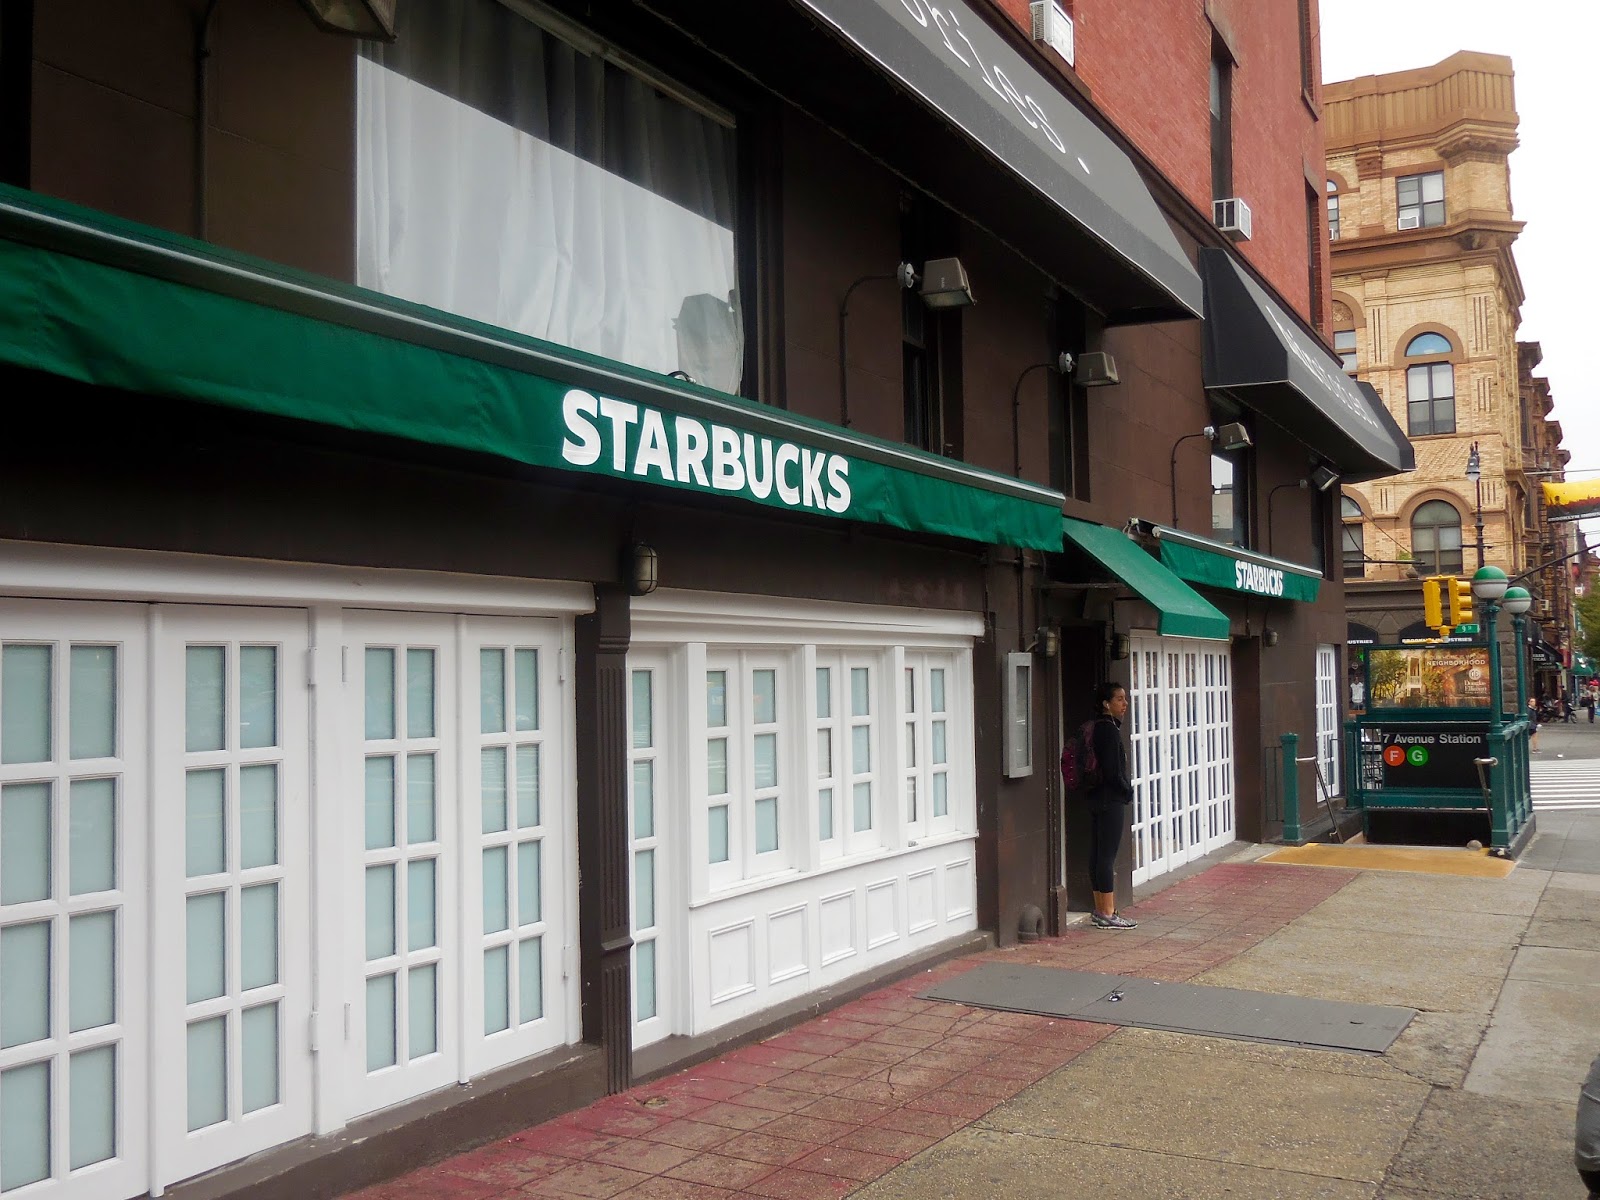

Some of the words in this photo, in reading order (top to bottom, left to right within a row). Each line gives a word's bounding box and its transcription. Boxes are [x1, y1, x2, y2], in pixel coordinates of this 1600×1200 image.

[561, 389, 852, 514] STARBUCKS
[1235, 559, 1284, 597] STARBUCKS
[1461, 625, 1467, 633] 9
[1382, 734, 1390, 744] 7
[1394, 734, 1435, 744] Avenue
[1439, 734, 1481, 744] Station
[1390, 750, 1399, 762] F
[1411, 750, 1423, 762] G
